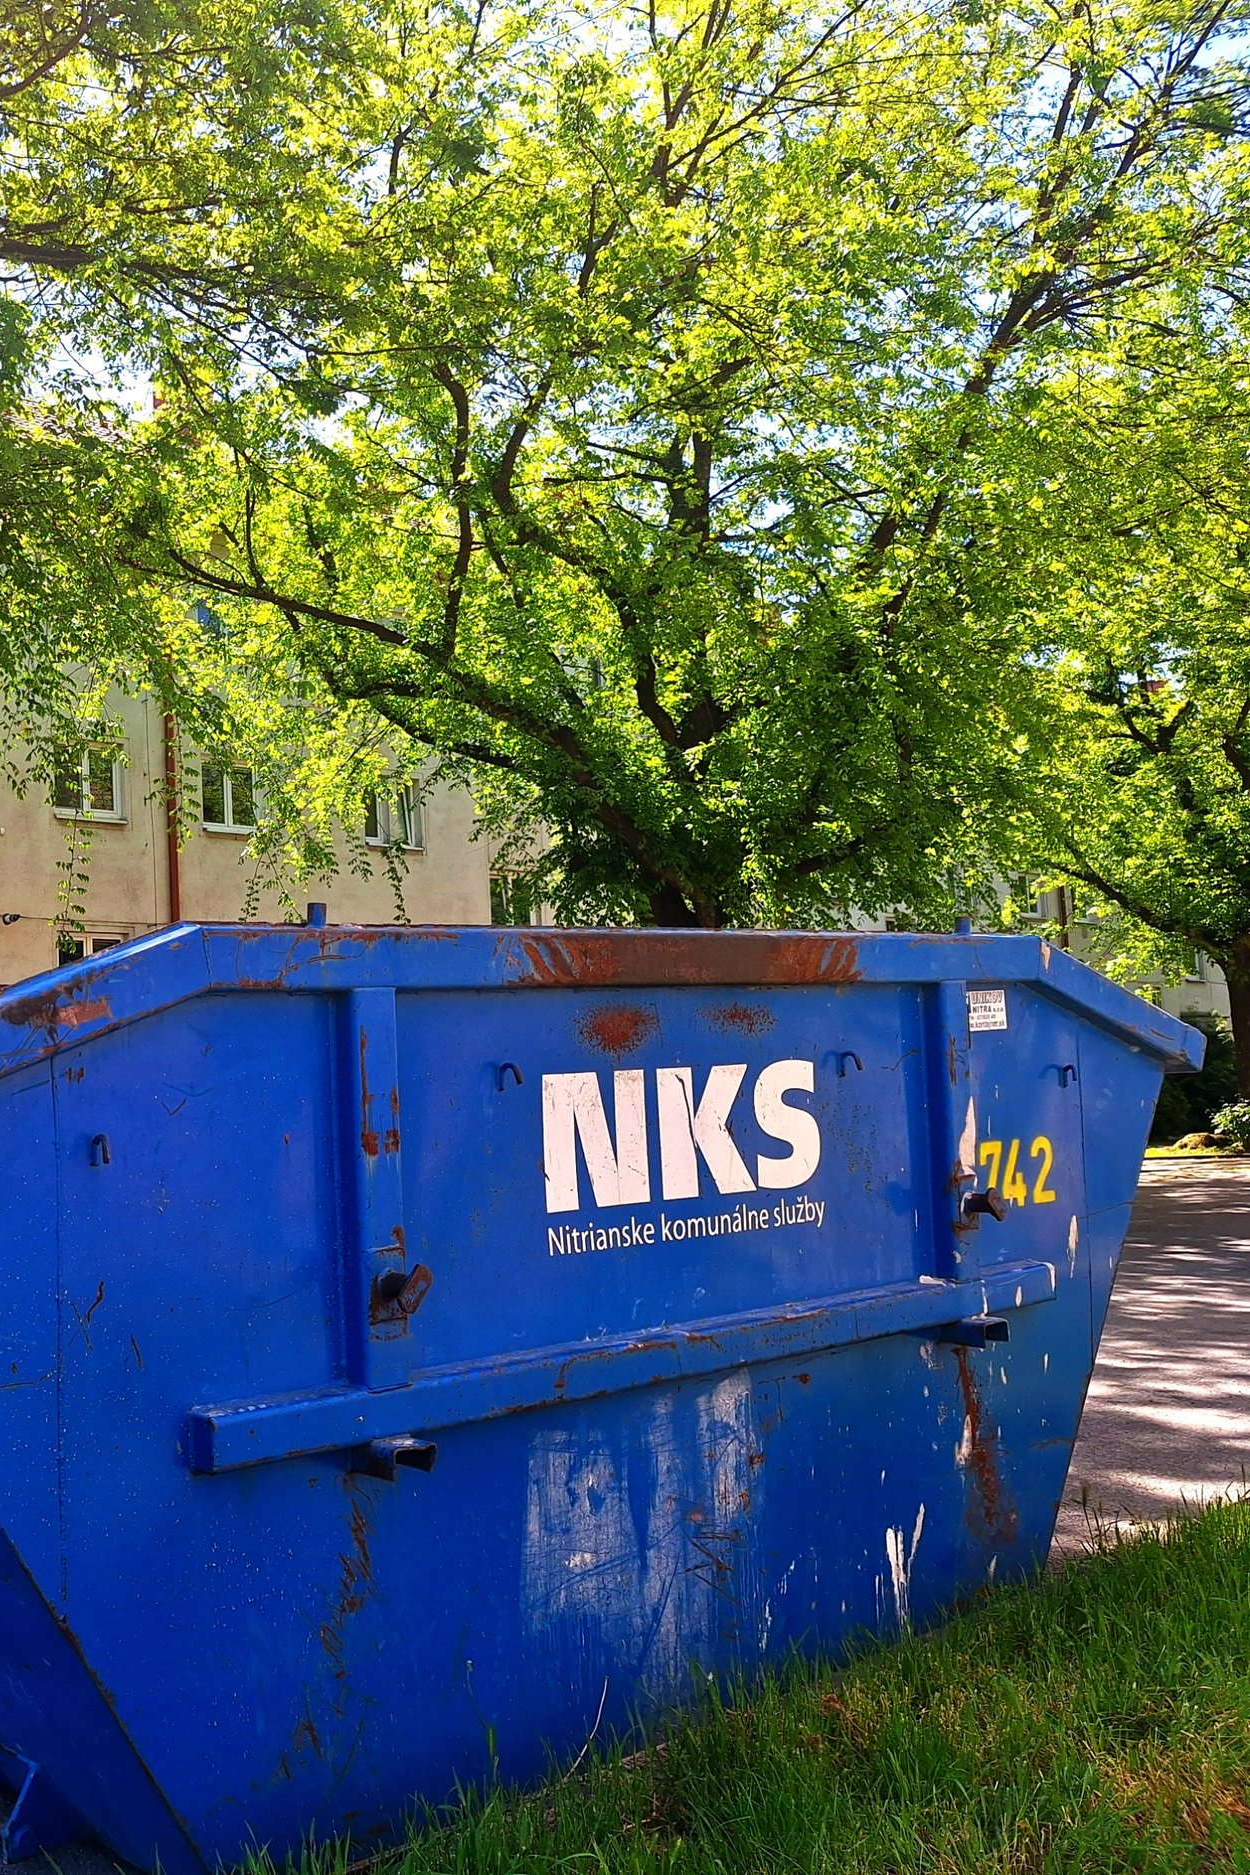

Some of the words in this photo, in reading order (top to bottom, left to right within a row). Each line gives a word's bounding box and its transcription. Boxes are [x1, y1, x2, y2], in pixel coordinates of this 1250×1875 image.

[972, 1005, 992, 1014] NITRA
[542, 1059, 821, 1213] NKS
[979, 1136, 1056, 1207] 742
[547, 1216, 655, 1256] Nitrianske
[661, 1203, 769, 1242] komunálne
[773, 1195, 825, 1229] služby
